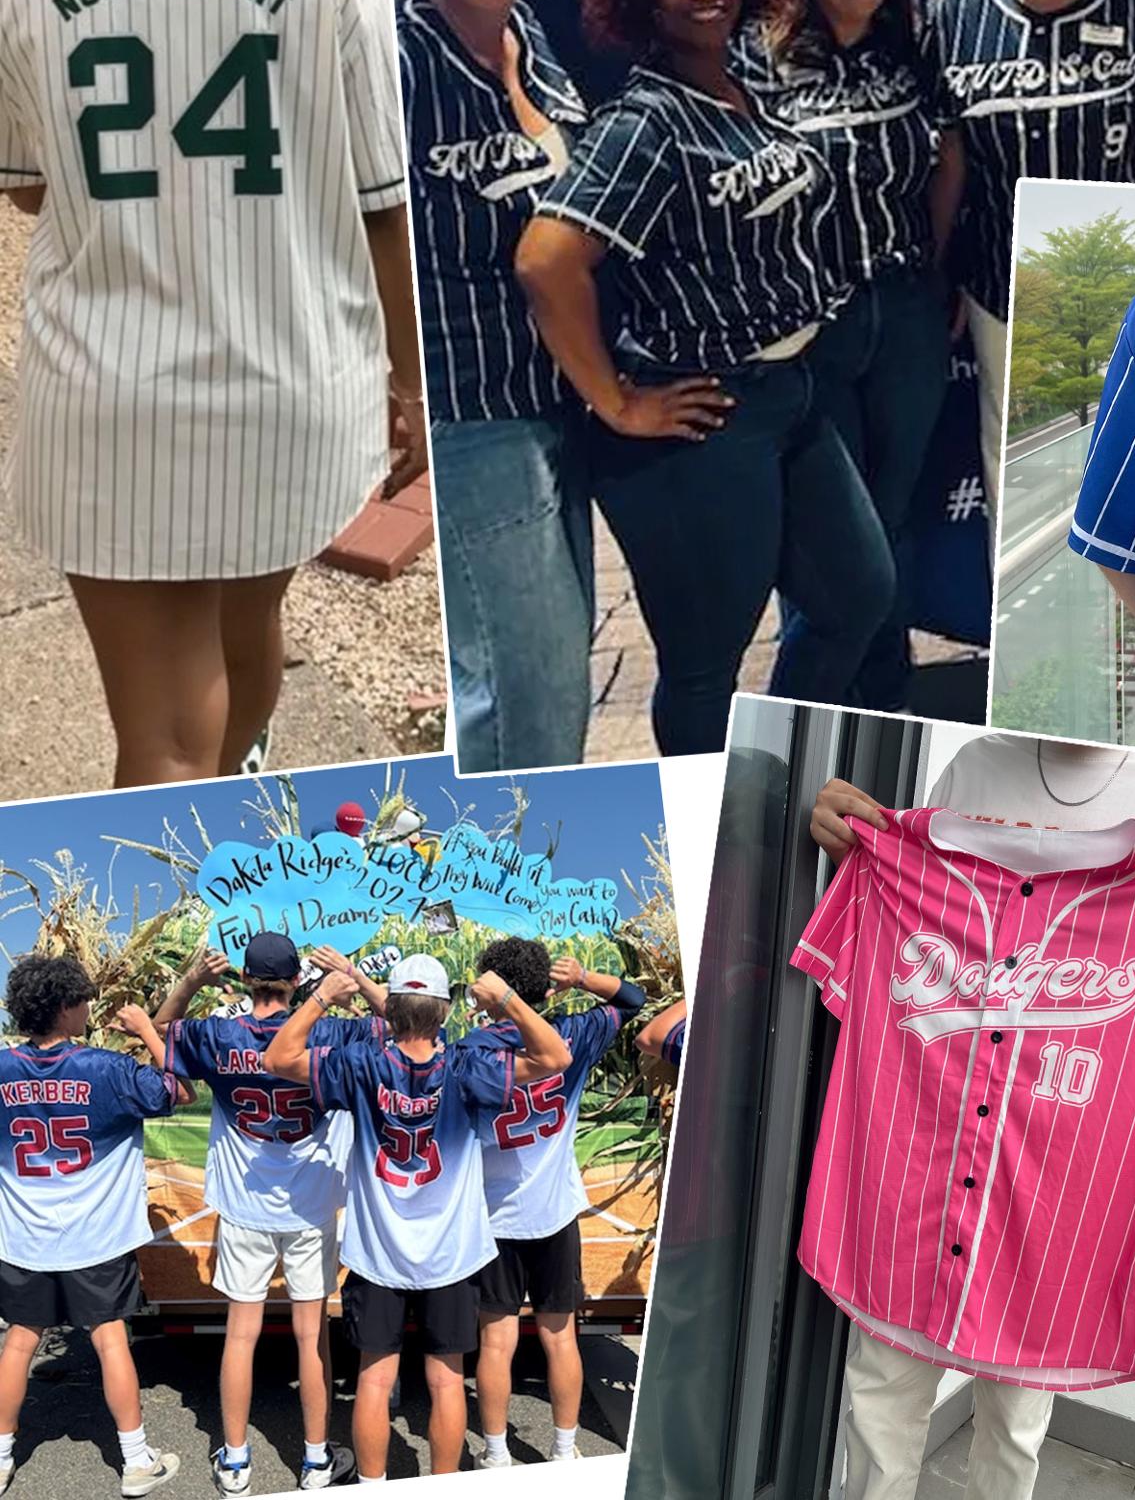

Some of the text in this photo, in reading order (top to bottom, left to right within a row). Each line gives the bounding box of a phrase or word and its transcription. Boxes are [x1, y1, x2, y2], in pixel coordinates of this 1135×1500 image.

[67, 31, 284, 201] 24
[1105, 123, 1128, 159] 9
[298, 898, 380, 932] Dreams
[216, 1048, 267, 1075] LAR
[1031, 1040, 1103, 1108] 10
[0, 1079, 92, 1107] KERBER
[231, 1086, 315, 1145] 25
[492, 1072, 568, 1153] 25
[10, 1114, 94, 1180] 25
